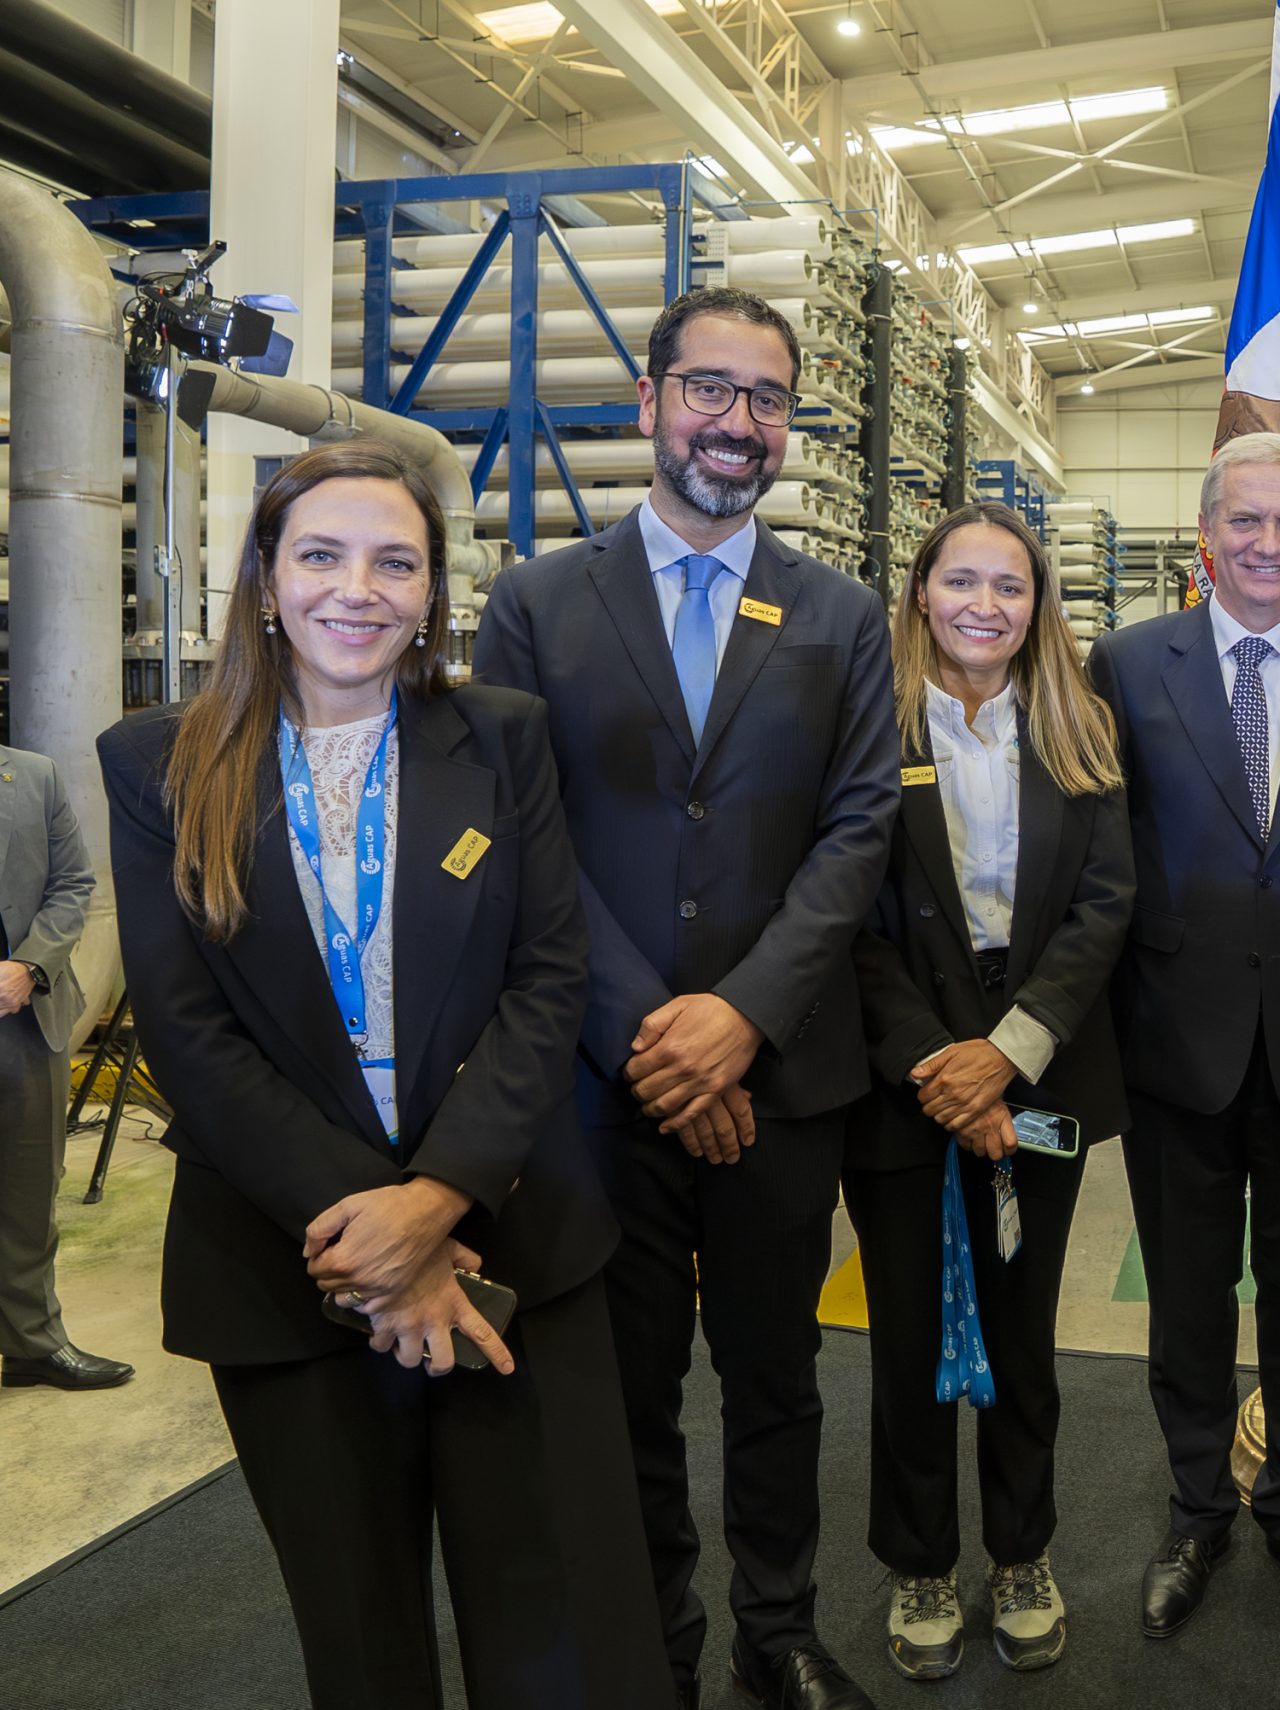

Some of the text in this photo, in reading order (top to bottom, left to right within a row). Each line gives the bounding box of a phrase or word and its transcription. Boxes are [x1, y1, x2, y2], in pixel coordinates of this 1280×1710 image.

[365, 825, 374, 870] Aguas CAP
[468, 836, 478, 849] CAP
[338, 938, 352, 983] Aguas CAP
